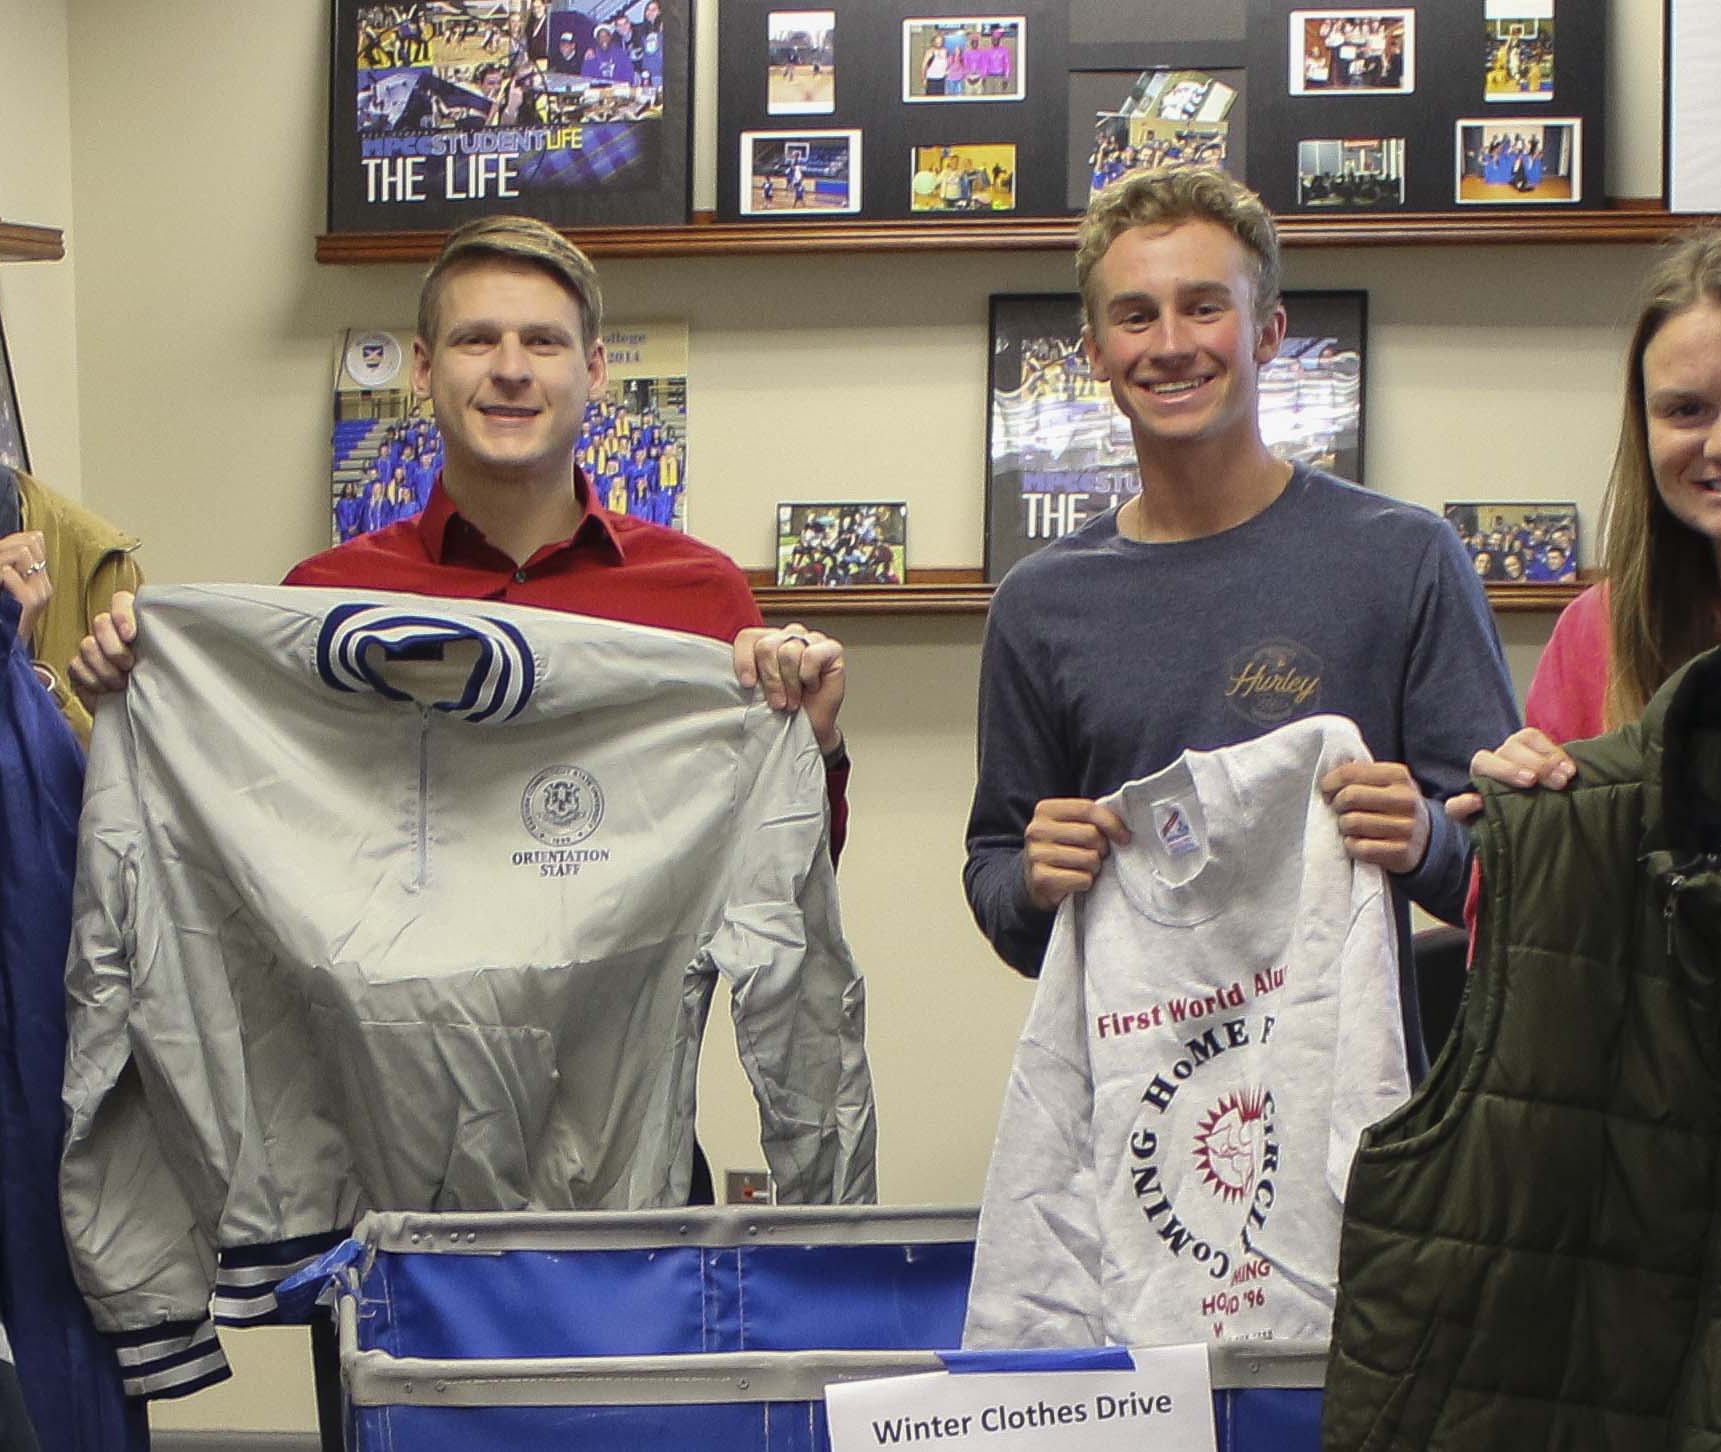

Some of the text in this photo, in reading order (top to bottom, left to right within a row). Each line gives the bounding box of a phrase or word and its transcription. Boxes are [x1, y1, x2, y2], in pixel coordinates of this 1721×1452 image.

[361, 151, 520, 203] THE LIFE
[1225, 661, 1321, 704] Hurley
[512, 848, 610, 866] ORIENTATION
[540, 863, 581, 877] STAFF
[1097, 1004, 1163, 1040] First
[1167, 982, 1246, 1024] World
[873, 1391, 1173, 1445] Winter Clothes Drive
